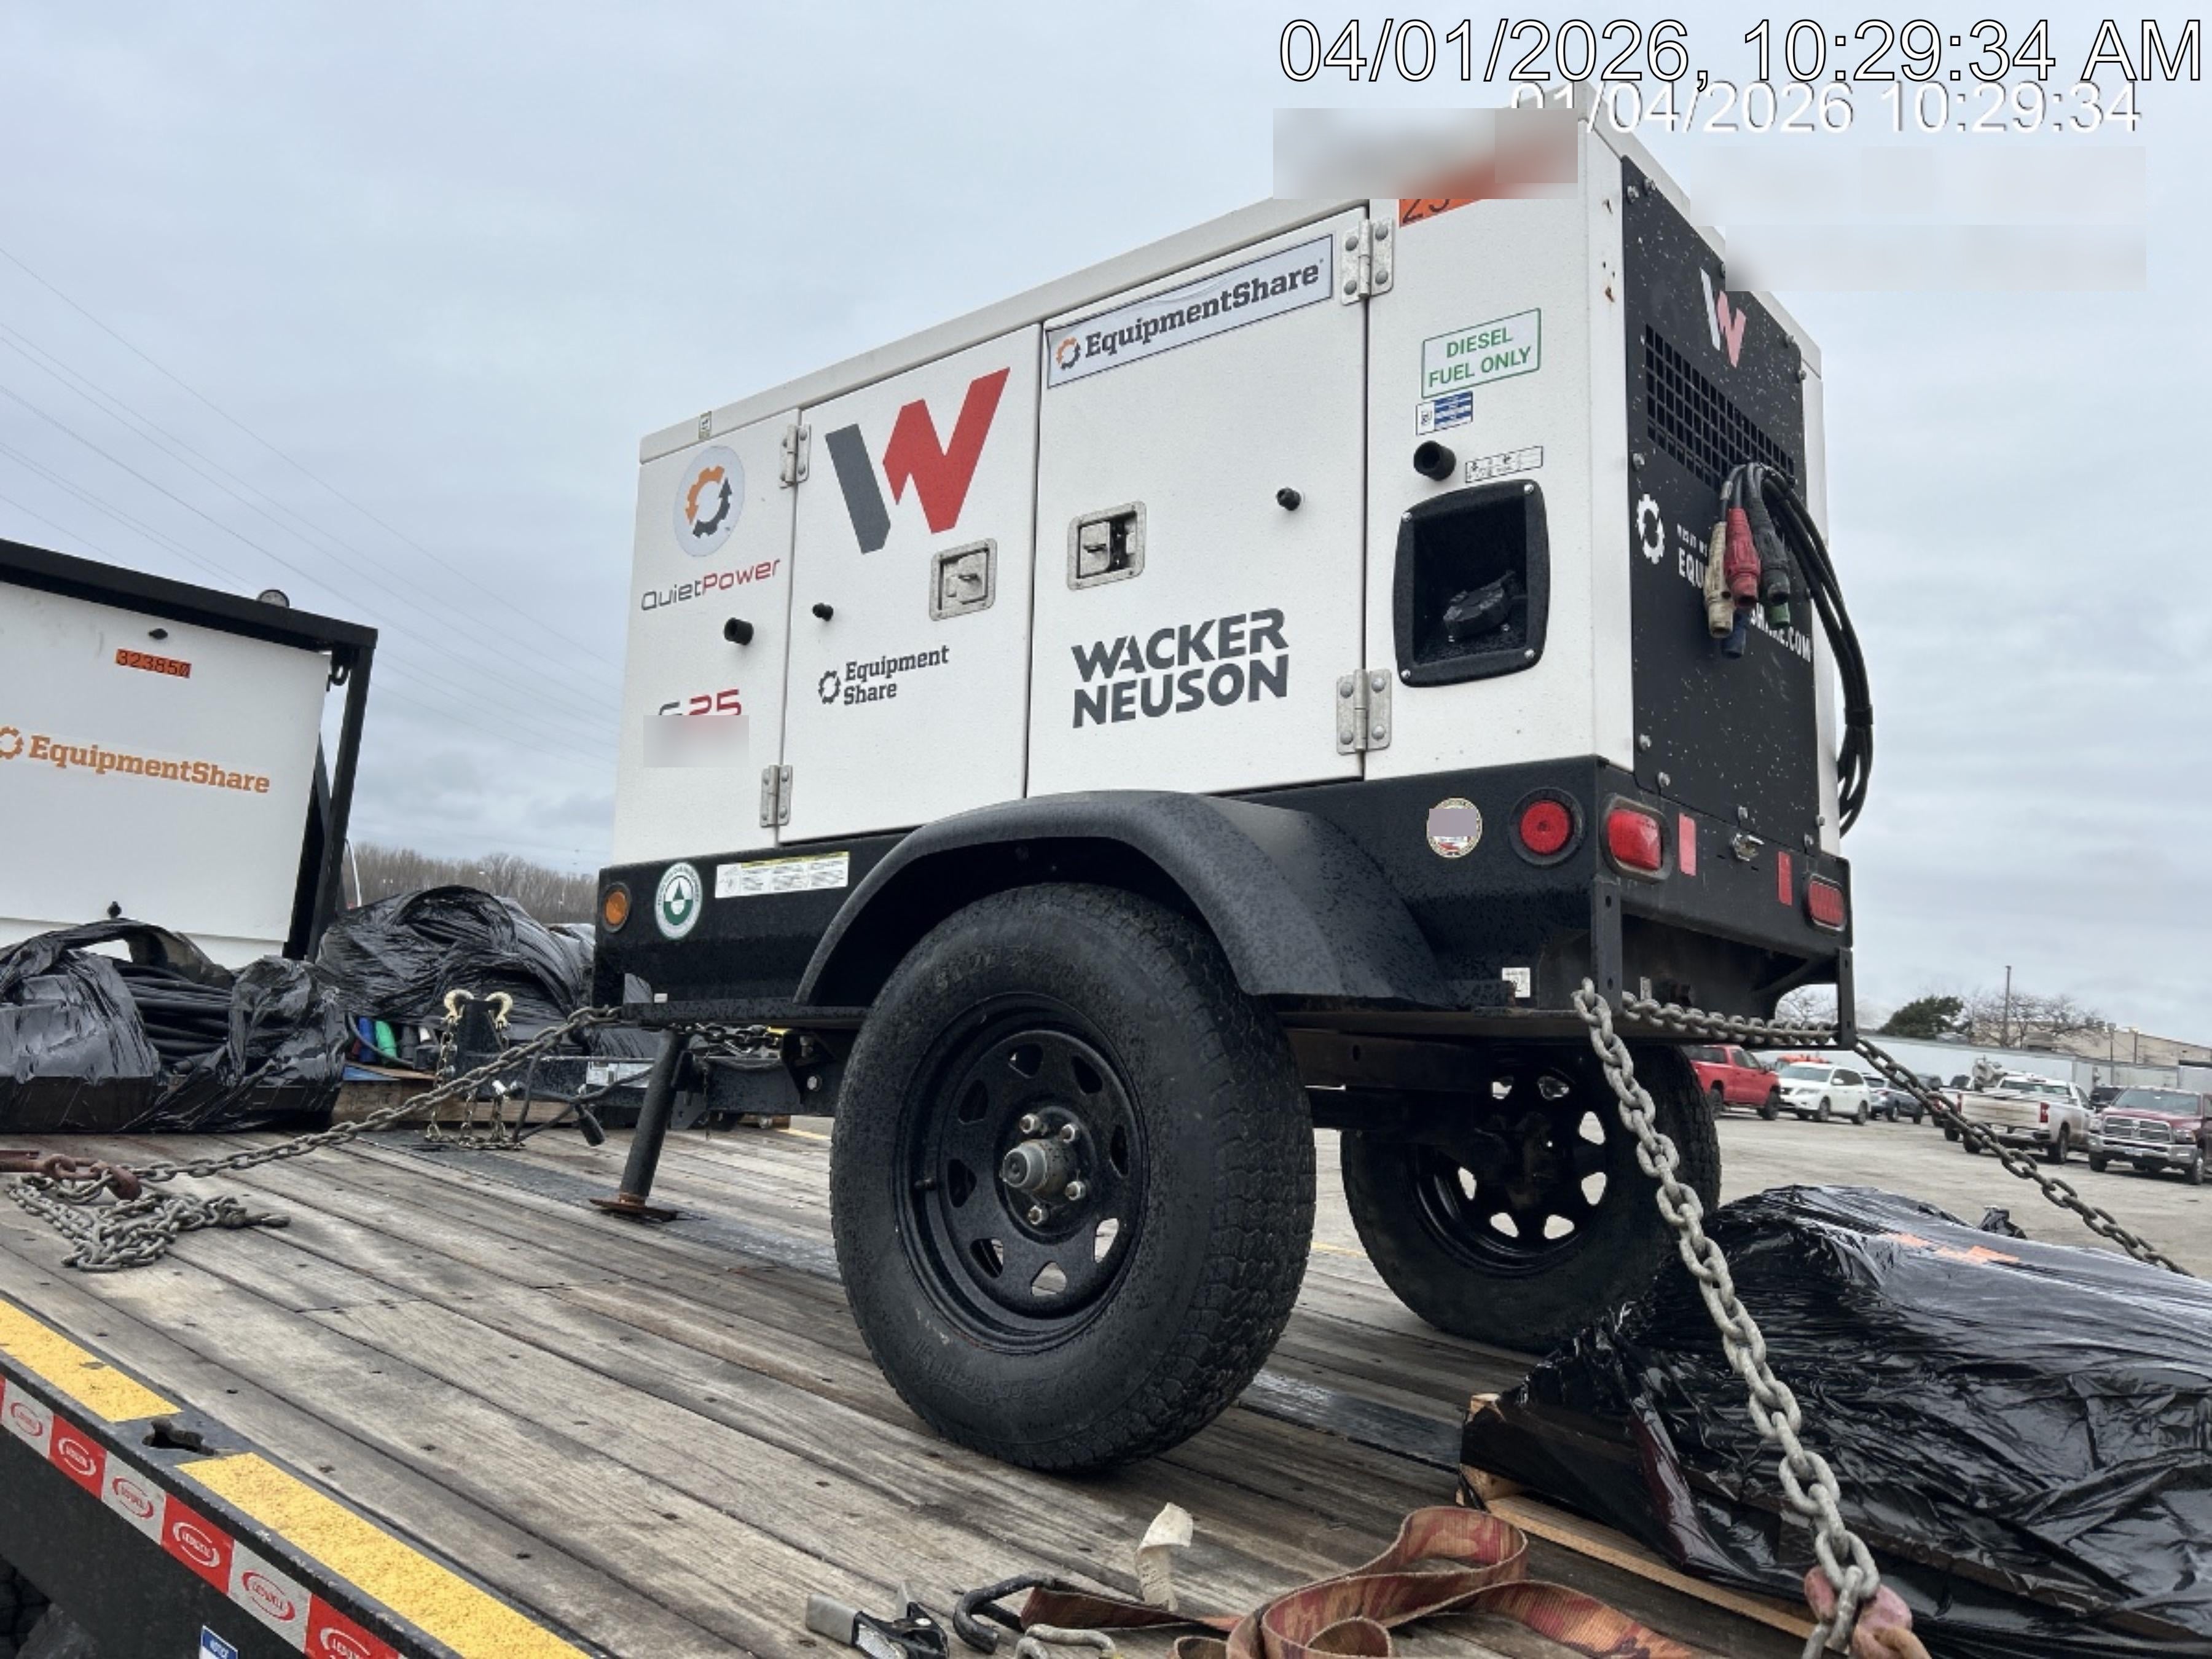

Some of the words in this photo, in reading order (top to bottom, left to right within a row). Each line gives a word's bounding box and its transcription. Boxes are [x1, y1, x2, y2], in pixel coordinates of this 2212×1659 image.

[1085, 263, 1319, 358] EquipmentShare
[1428, 363, 1475, 388] FUEL
[1480, 346, 1531, 374] ONLY
[1446, 327, 1513, 358] DIESEL
[641, 558, 780, 611] QuietPower
[845, 645, 949, 682] Equipment
[1071, 608, 1289, 683] WACKER
[844, 680, 897, 706] Share
[1072, 654, 1289, 729] NEUSON
[29, 734, 270, 793] EquipmentShare
